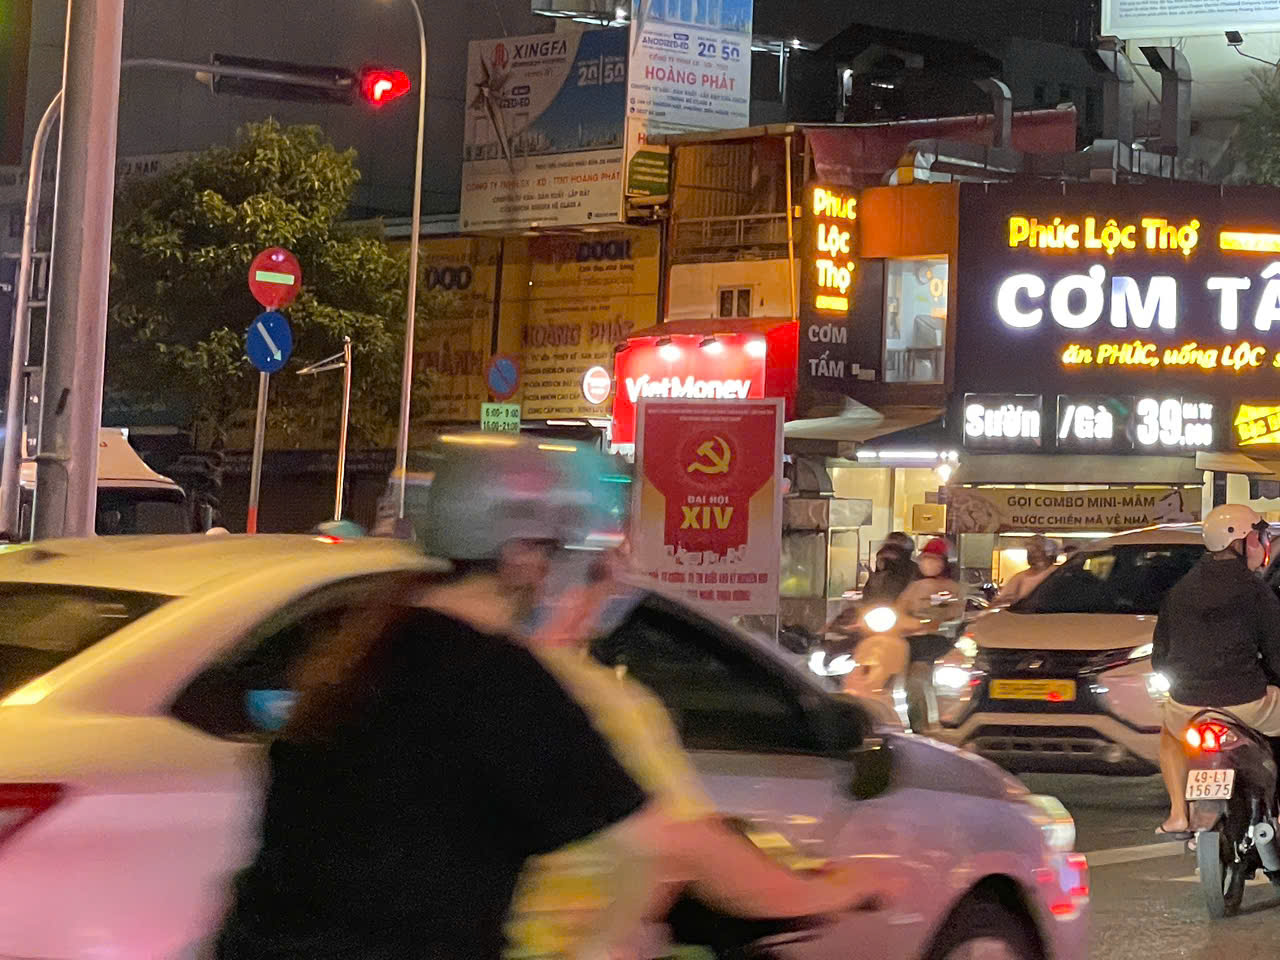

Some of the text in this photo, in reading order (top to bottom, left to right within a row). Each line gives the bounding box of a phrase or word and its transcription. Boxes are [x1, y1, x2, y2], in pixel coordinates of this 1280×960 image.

[512, 40, 567, 59] XINGFA
[644, 65, 736, 91] HOÀNG PHÁT
[813, 187, 857, 220] Phúc
[816, 223, 851, 257] Lộc
[1008, 216, 1080, 251] Phúc
[1084, 216, 1137, 256] Lộc
[996, 263, 1178, 330] CƠM
[808, 323, 847, 344] CƠM
[808, 350, 845, 378] TẤM
[1221, 341, 1266, 371] LỘC
[625, 374, 752, 403] VietMoney
[965, 404, 1041, 438] Sườn
[1058, 404, 1114, 440] /Gà
[709, 495, 729, 505] HỘI
[1007, 495, 1032, 509] GỌI
[1035, 496, 1084, 508] COMBO
[680, 506, 735, 530] XIV
[1194, 771, 1227, 784] 49-L1
